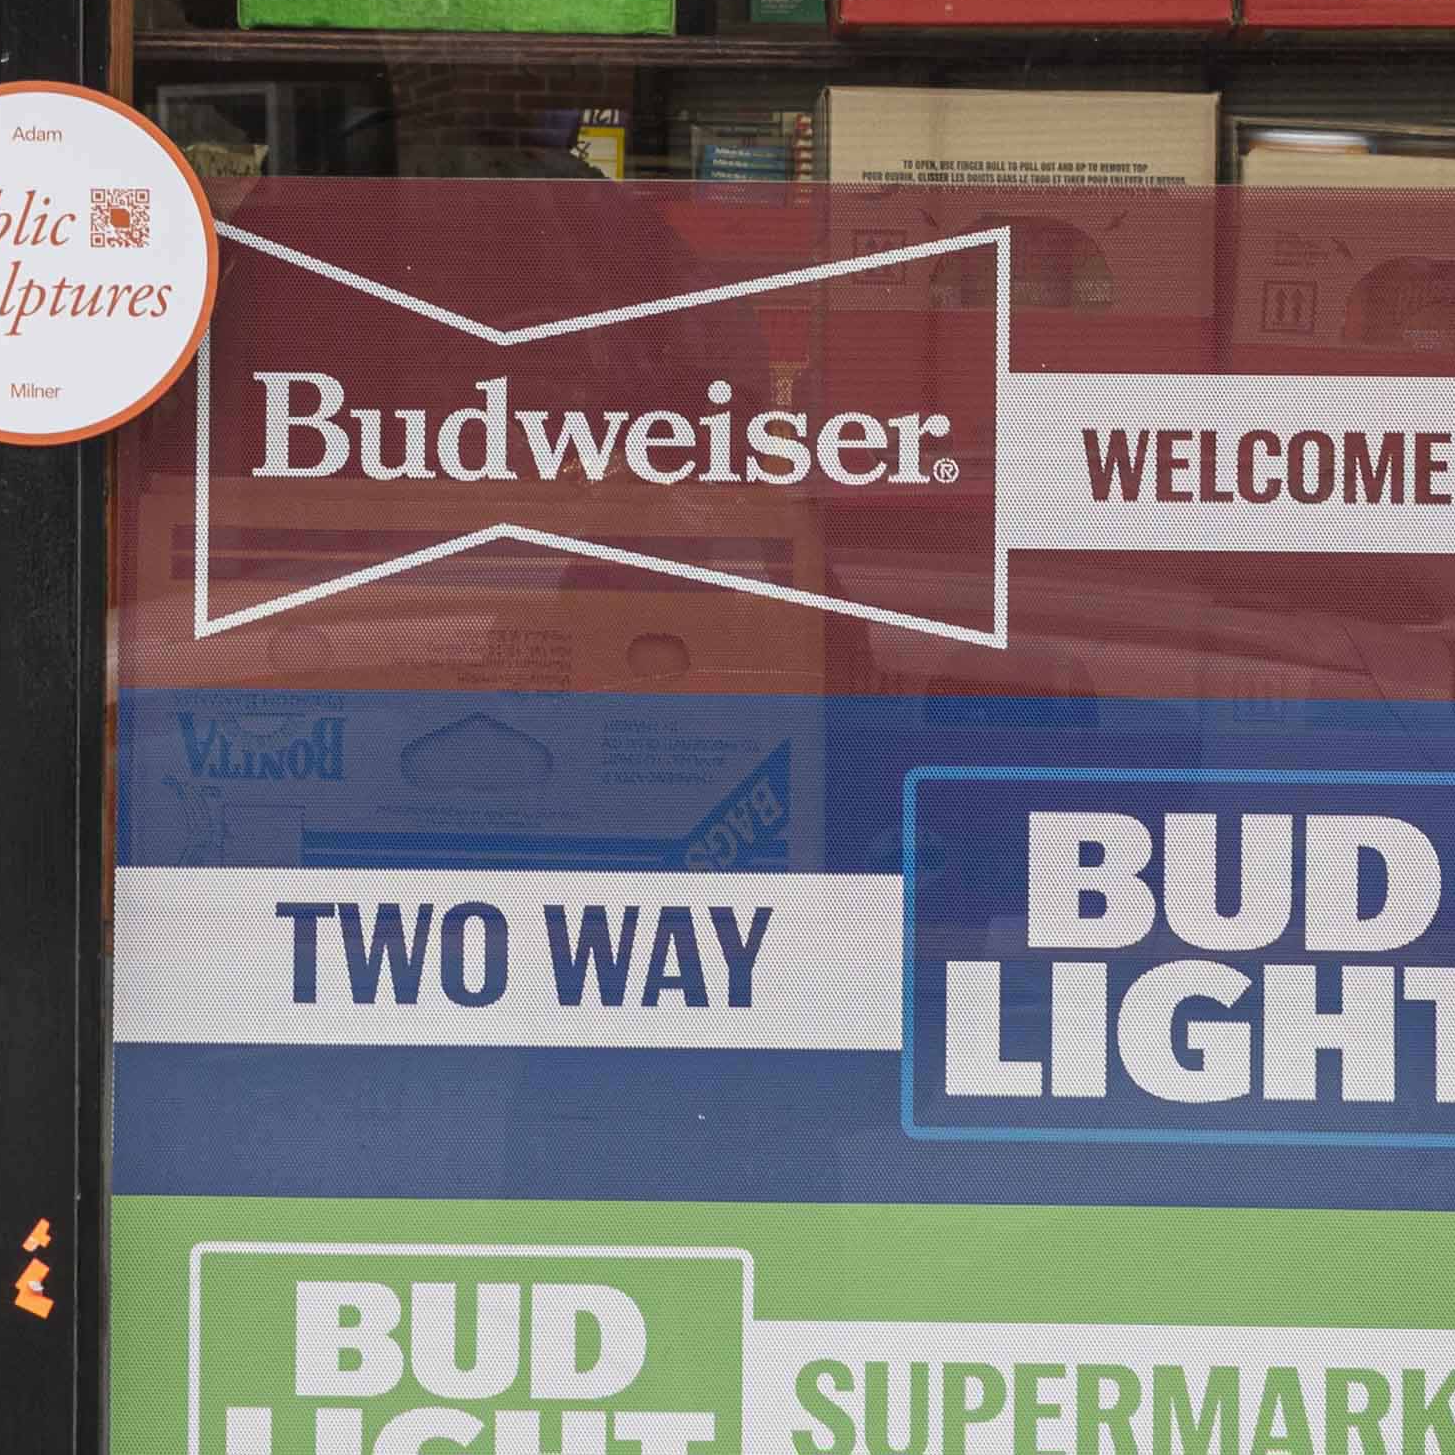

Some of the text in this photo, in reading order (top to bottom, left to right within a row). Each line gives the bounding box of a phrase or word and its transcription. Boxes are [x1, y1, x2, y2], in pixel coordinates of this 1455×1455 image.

[12, 126, 63, 143] Adam
[10, 382, 62, 399] Milner
[251, 370, 949, 487] Budweiser
[1082, 427, 1452, 507] WELCOME
[1027, 810, 1442, 953] BUD
[275, 901, 775, 1009] TWO WAY
[293, 1279, 648, 1402] BUD
